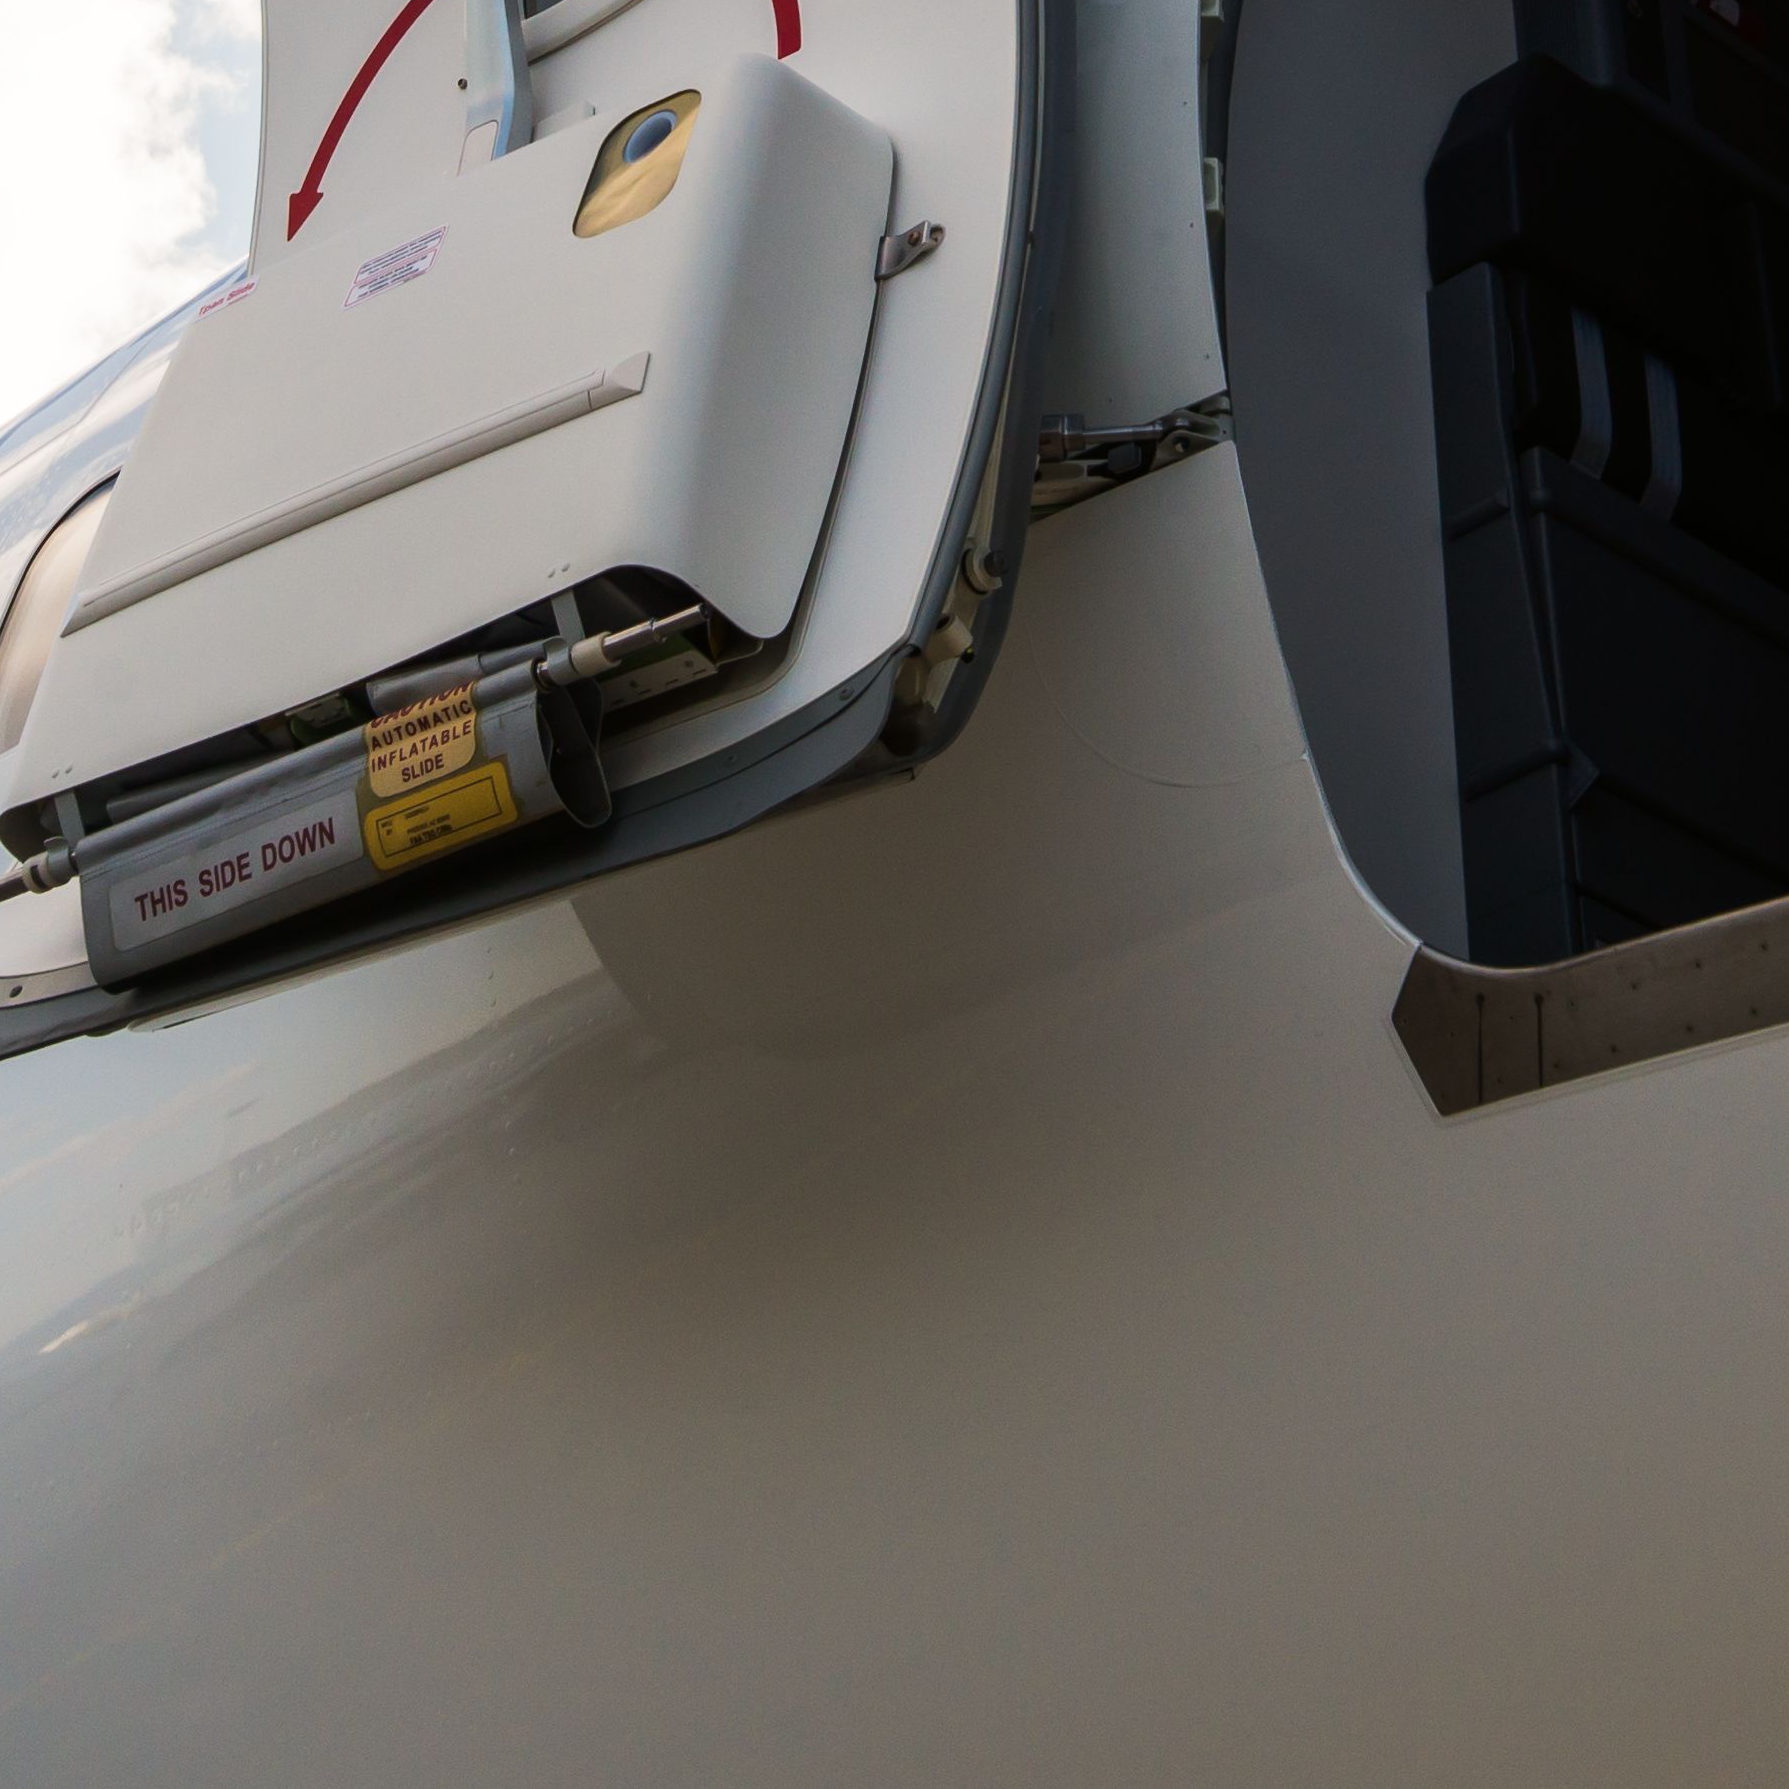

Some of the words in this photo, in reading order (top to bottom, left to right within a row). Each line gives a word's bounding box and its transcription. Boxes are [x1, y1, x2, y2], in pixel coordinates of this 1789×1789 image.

[371, 720, 472, 772] INFLATABLE
[372, 699, 473, 751] AUTOMATIC
[401, 753, 445, 783] SLIDE
[134, 879, 189, 921] THIS
[198, 851, 253, 897] SIDE
[261, 817, 336, 871] DOWN
